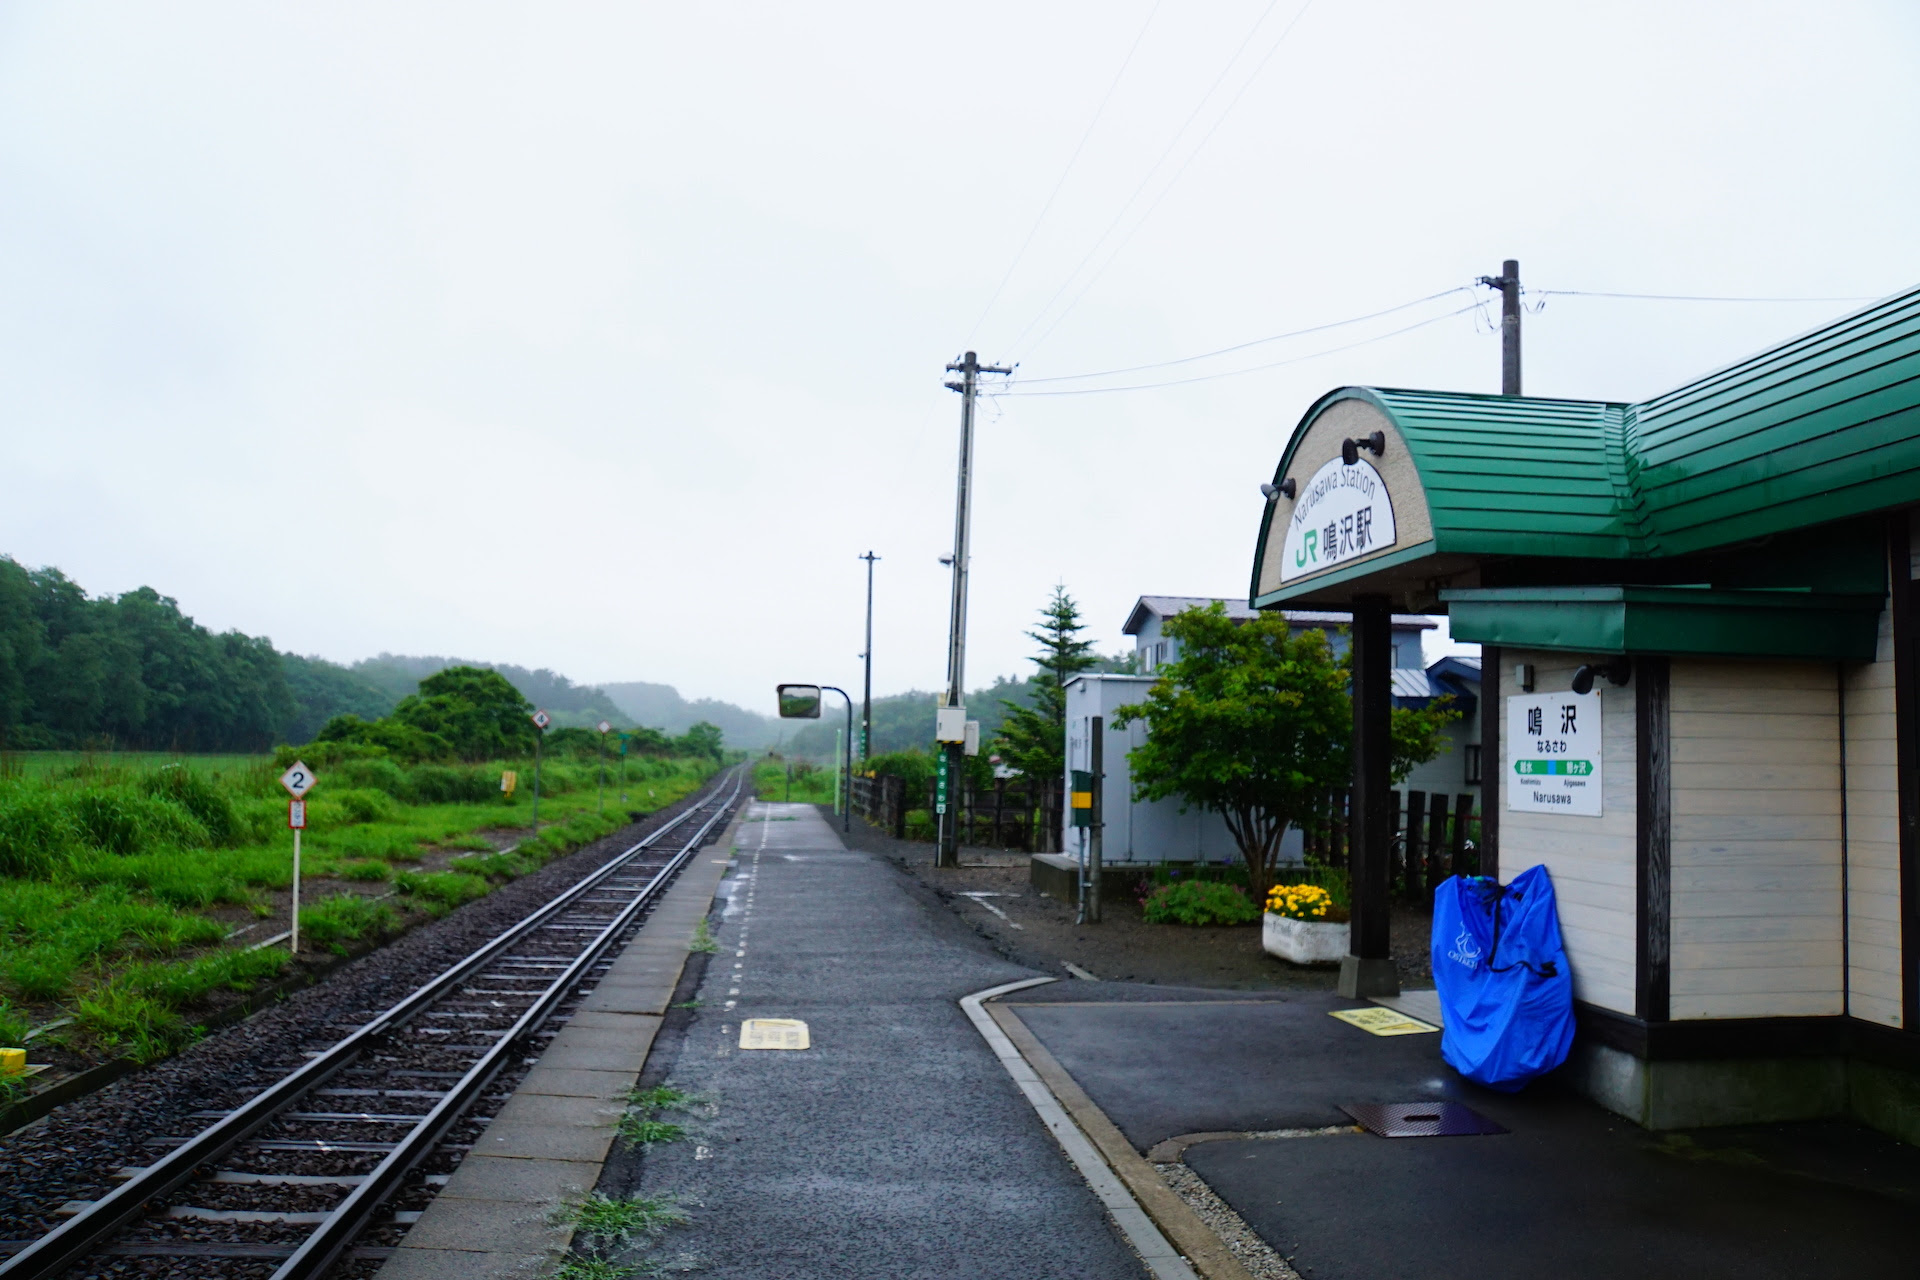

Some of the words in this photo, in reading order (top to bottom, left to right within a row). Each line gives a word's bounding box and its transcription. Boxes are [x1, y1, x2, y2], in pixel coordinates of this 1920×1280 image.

[1294, 471, 1338, 531] Narusawa
[1340, 464, 1376, 501] Station
[1296, 528, 1318, 568] JR
[1323, 506, 1373, 561] 鳴沢駅
[1528, 704, 1577, 736] 鳴沢
[1537, 740, 1567, 753] なるさわ
[292, 772, 304, 789] 2
[1533, 791, 1571, 804] Narusawa
